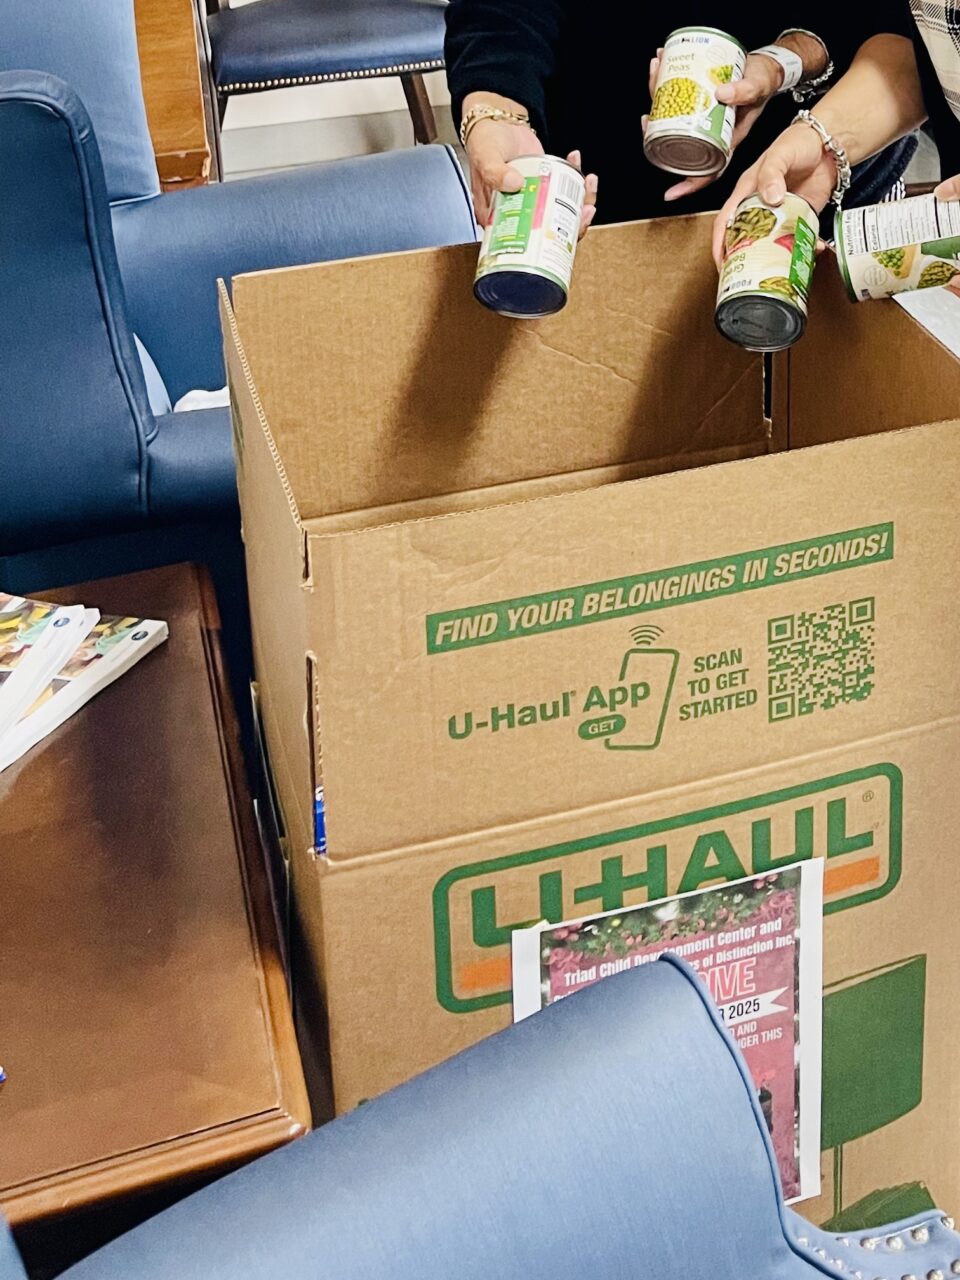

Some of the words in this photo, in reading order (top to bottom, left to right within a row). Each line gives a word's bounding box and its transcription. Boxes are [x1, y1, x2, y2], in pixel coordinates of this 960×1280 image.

[435, 612, 498, 646] FIND
[506, 597, 575, 632] YOUR
[581, 564, 736, 618] BELONGINGS
[742, 557, 769, 584] IN
[773, 531, 889, 578] SECONDS!
[693, 647, 743, 673] SCAN
[687, 676, 711, 697] TO
[715, 668, 750, 692] GET
[447, 691, 572, 741] U-Haul
[582, 680, 651, 713] App
[678, 688, 758, 722] STARTED
[588, 718, 618, 736] GET
[471, 797, 874, 948] U-HAUL
[564, 965, 597, 987] Triad
[599, 954, 632, 979] Child
[717, 927, 757, 946] Center
[759, 918, 783, 936] and
[702, 955, 714, 968] of
[716, 941, 773, 965] Distinction
[775, 933, 796, 949] Inc.
[728, 998, 761, 1020] 2025
[736, 1020, 758, 1037] AND
[760, 1026, 783, 1043] THIS
